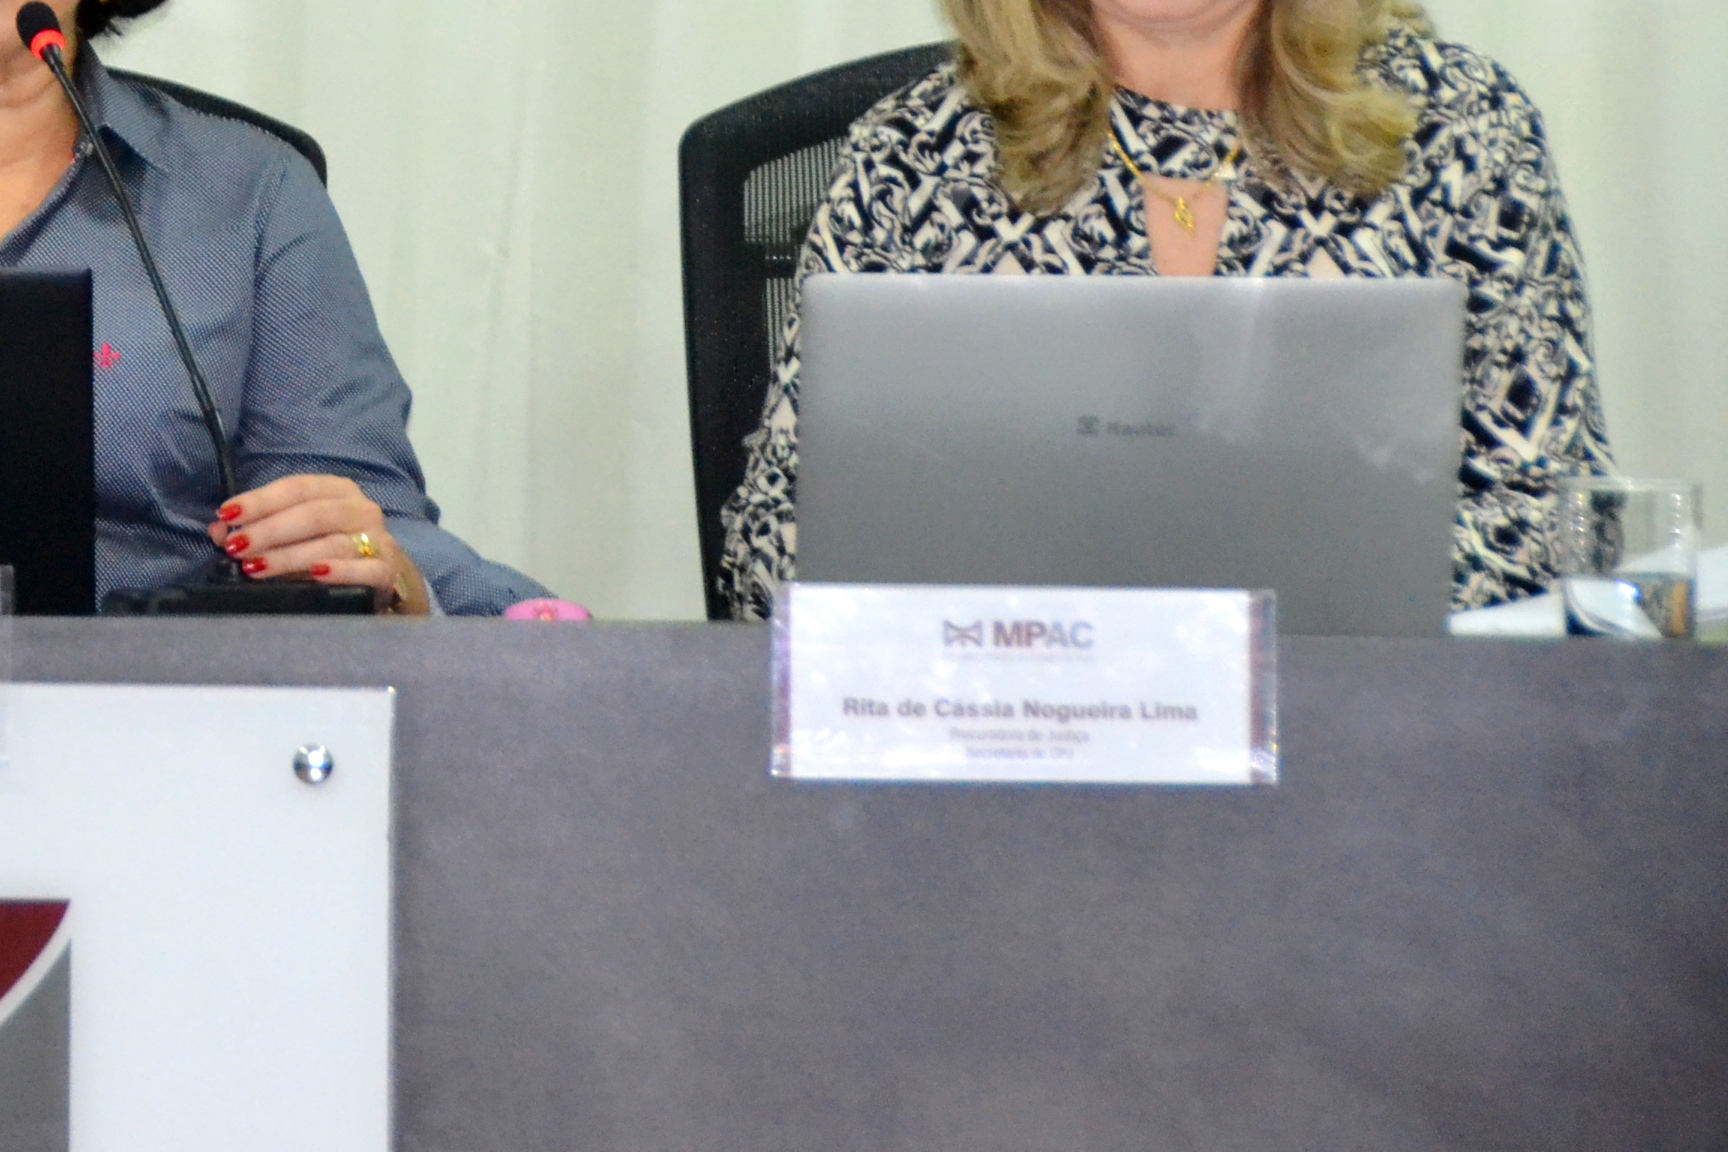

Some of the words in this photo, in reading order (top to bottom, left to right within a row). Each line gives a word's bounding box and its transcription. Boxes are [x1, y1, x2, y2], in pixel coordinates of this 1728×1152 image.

[993, 619, 1095, 648] MPAC
[843, 697, 889, 717] Rita
[897, 697, 926, 718] de
[1023, 699, 1132, 723] Nogueira
[1141, 701, 1198, 721] Lima
